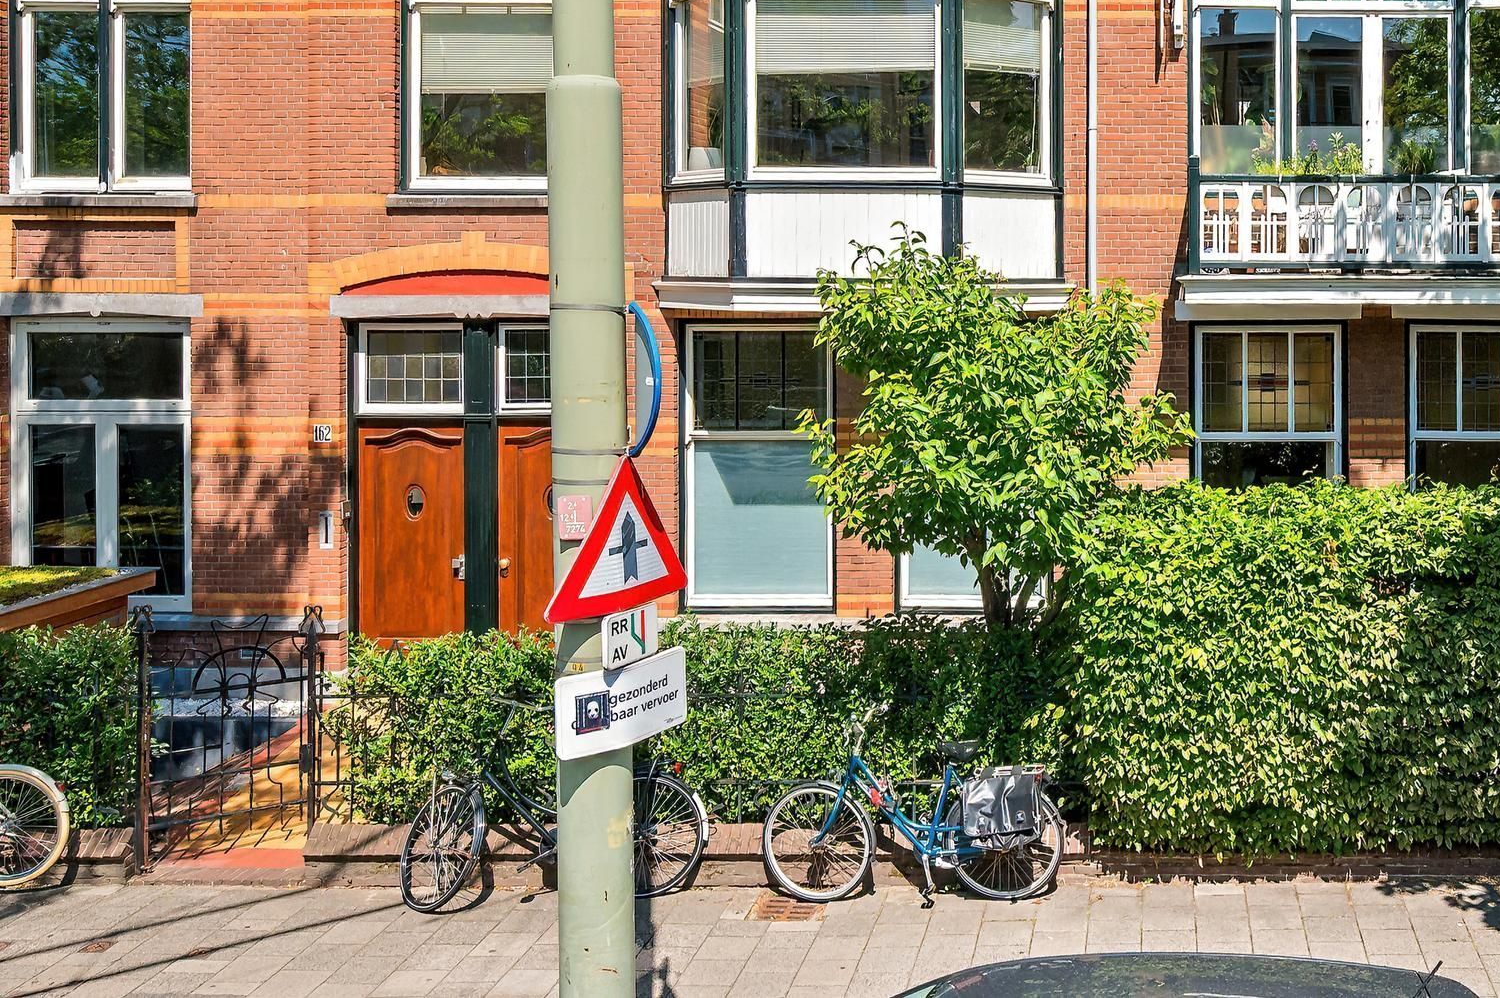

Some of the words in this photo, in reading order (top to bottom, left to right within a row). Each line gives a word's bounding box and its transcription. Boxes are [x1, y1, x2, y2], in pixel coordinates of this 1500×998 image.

[314, 425, 331, 442] 162
[611, 618, 628, 637] RR
[612, 644, 628, 663] AV
[608, 673, 668, 708] gezonderd
[641, 689, 679, 712] vervoer
